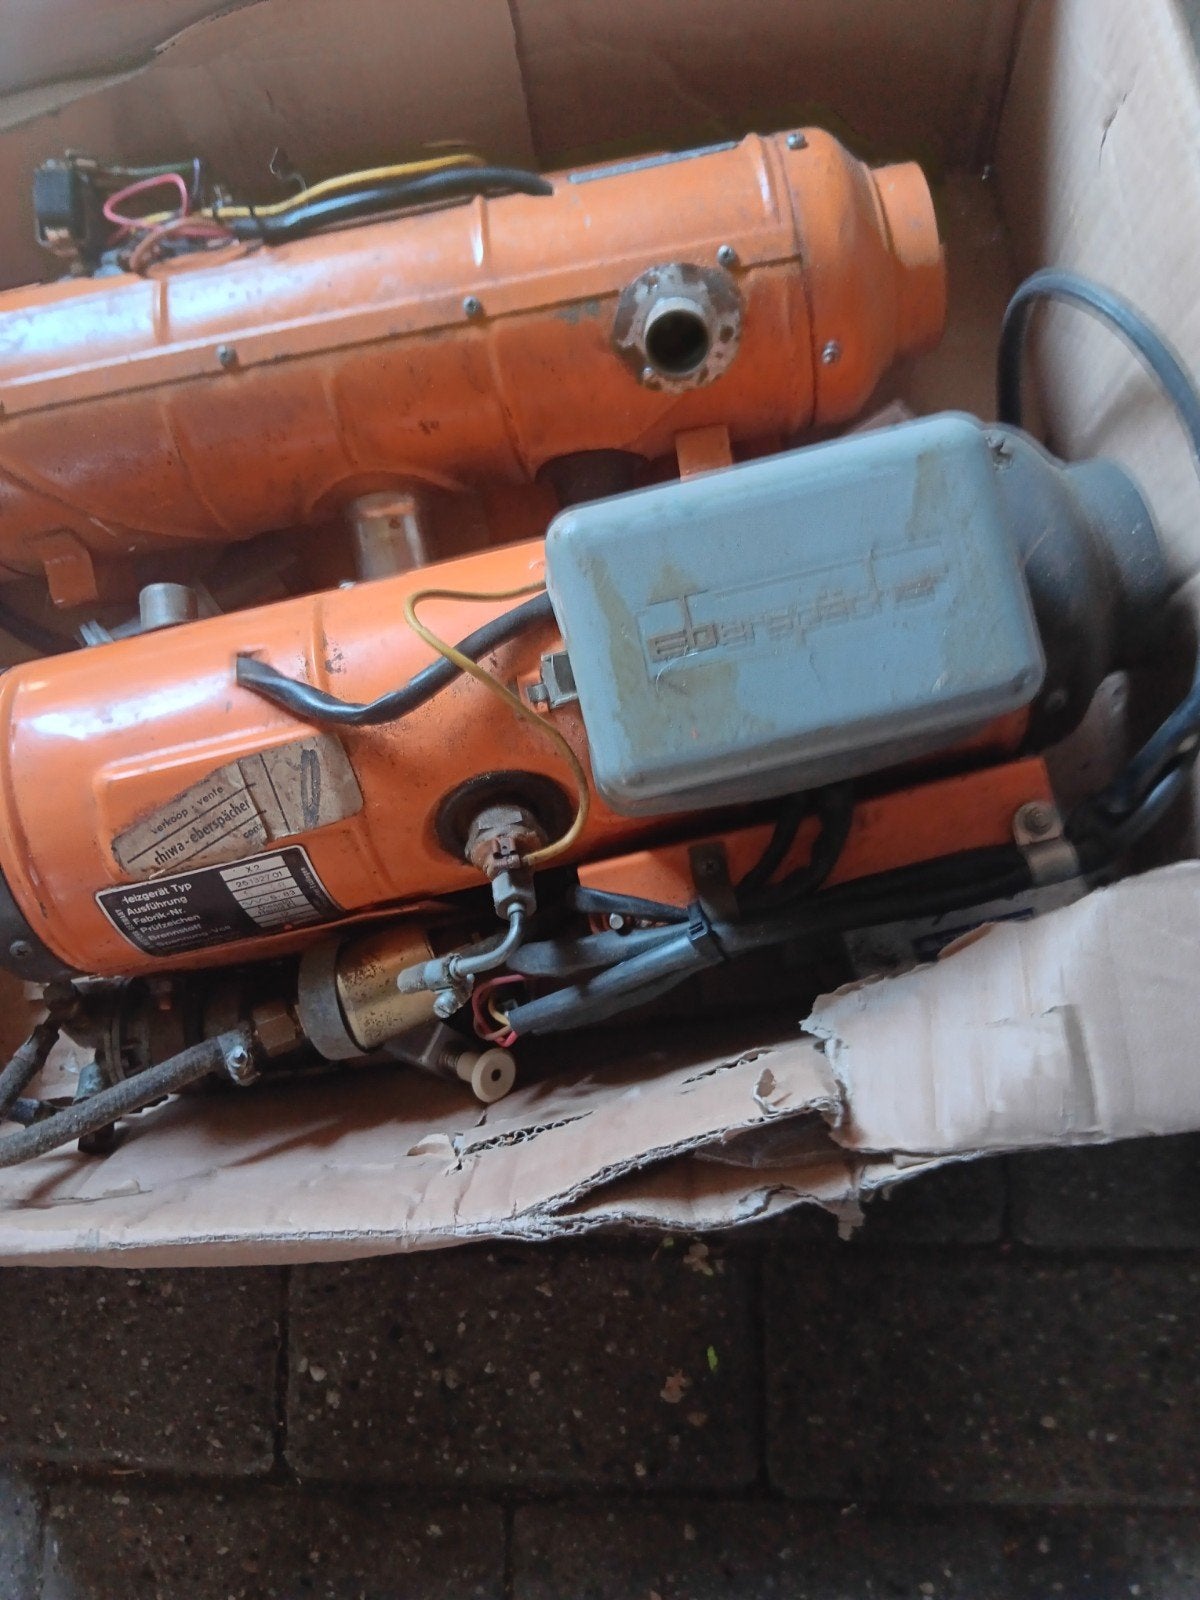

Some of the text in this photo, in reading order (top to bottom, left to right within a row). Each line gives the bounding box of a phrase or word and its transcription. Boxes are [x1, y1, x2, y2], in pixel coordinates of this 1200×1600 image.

[151, 786, 224, 835] verkoop vente
[170, 882, 192, 893] Typ
[126, 896, 188, 916] Ausführung
[140, 914, 201, 933] Prüfzeichen
